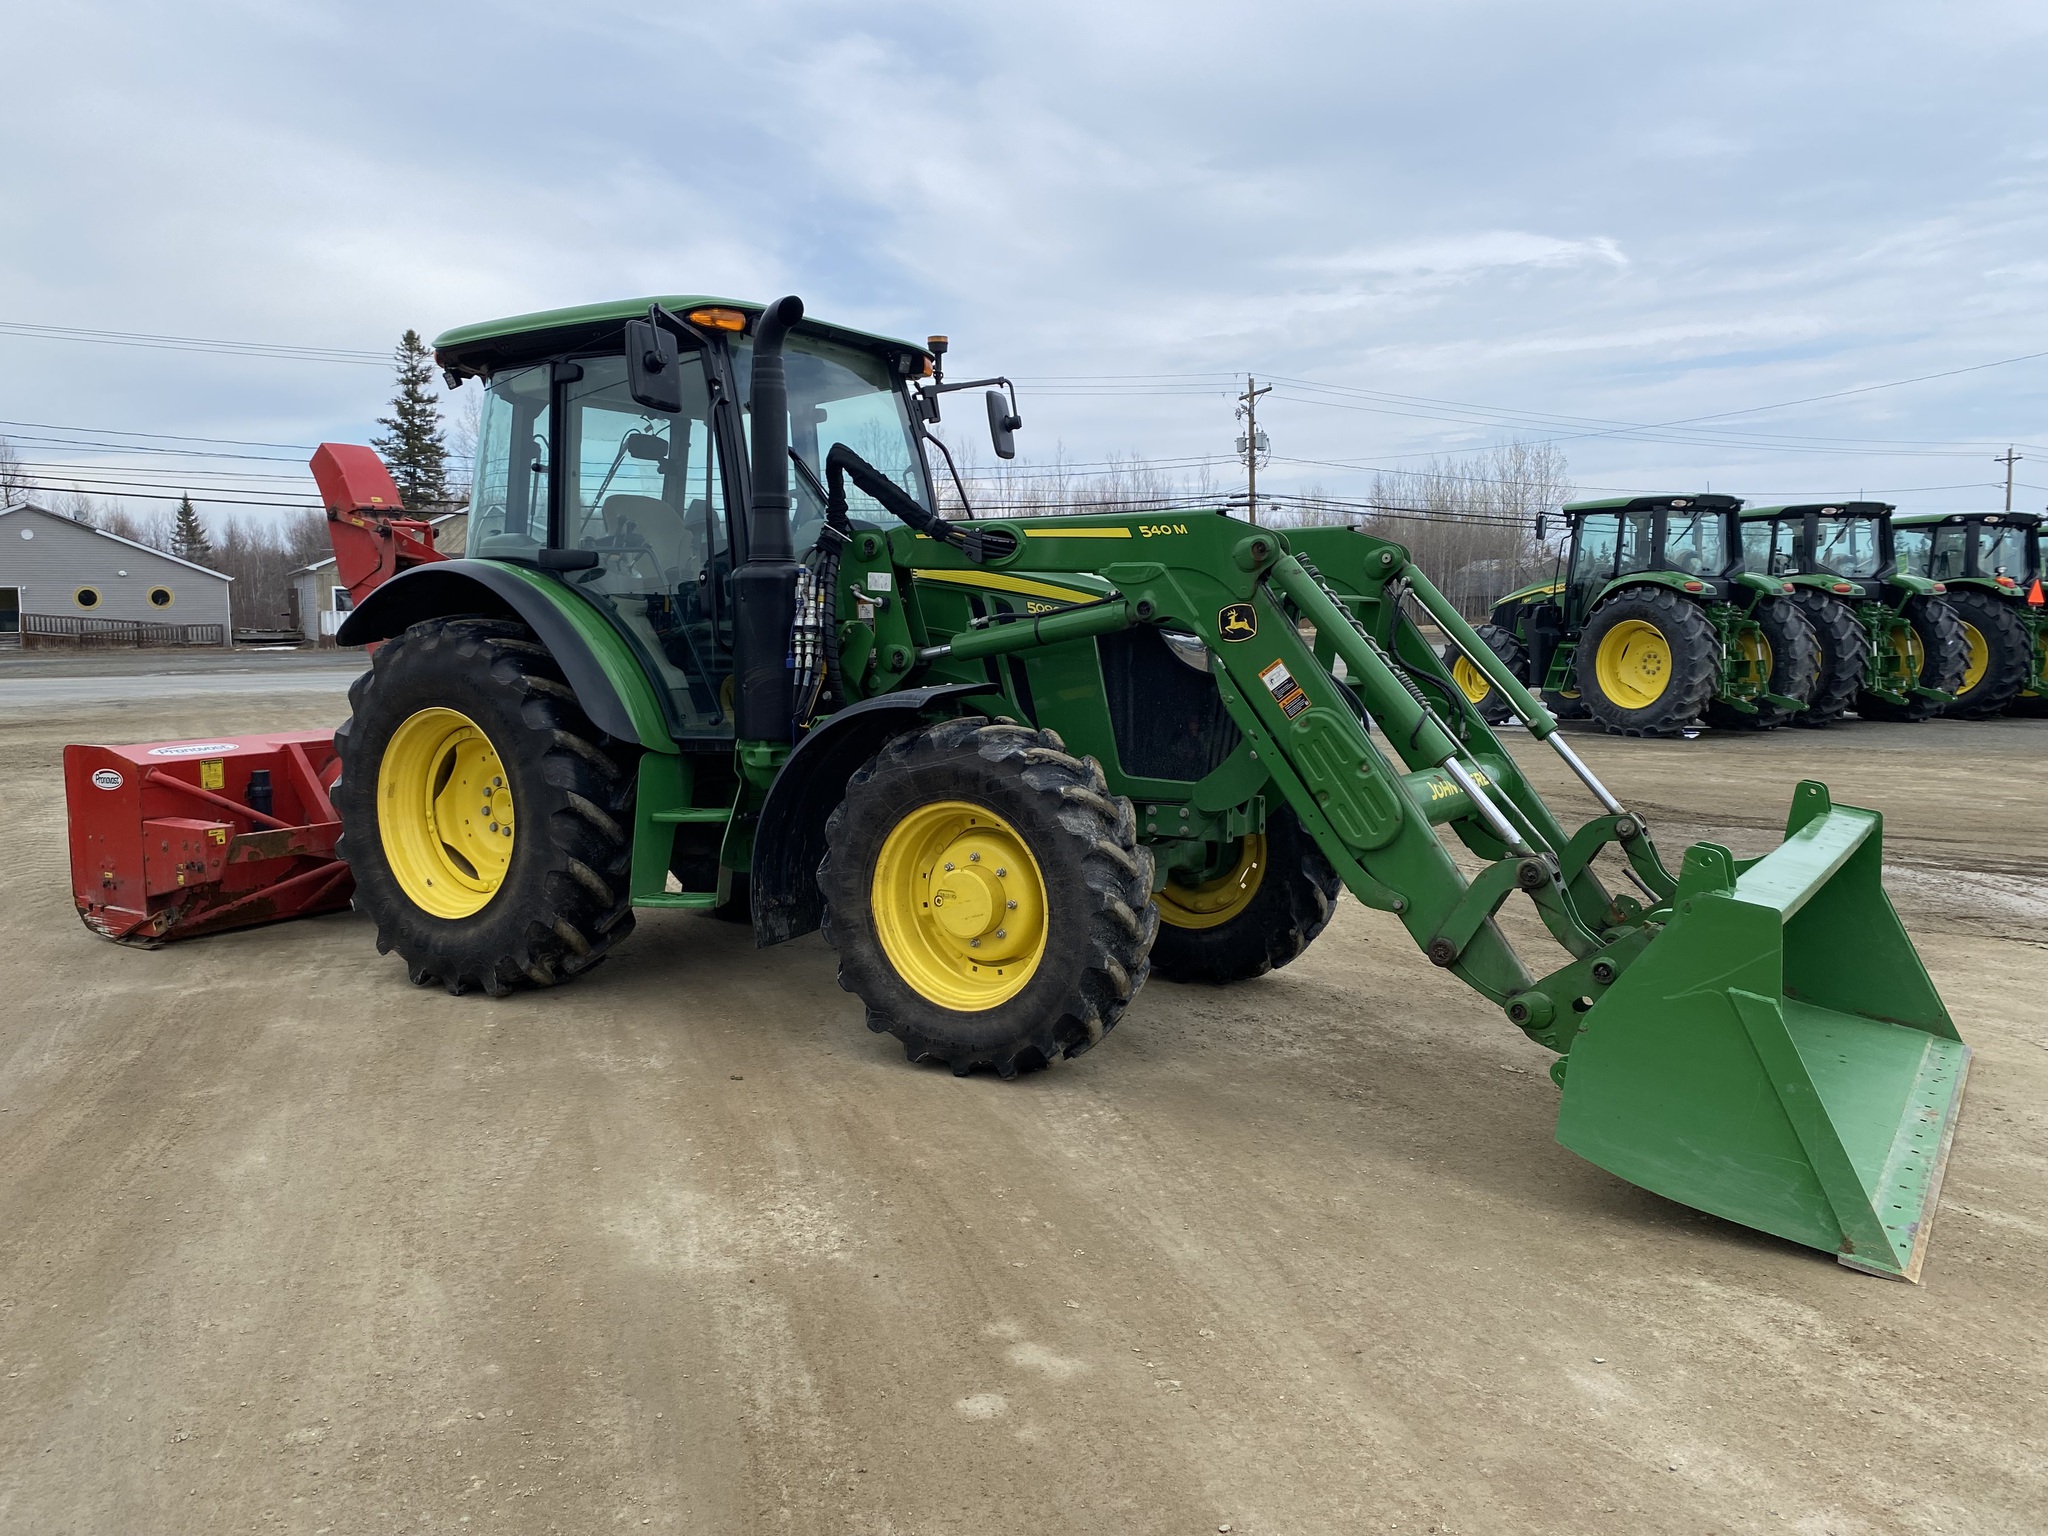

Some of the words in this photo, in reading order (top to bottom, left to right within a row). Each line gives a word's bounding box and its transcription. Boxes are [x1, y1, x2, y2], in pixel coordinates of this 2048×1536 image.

[1138, 525, 1172, 538] 540
[1173, 524, 1188, 535] M
[1426, 780, 1459, 801] JOHN
